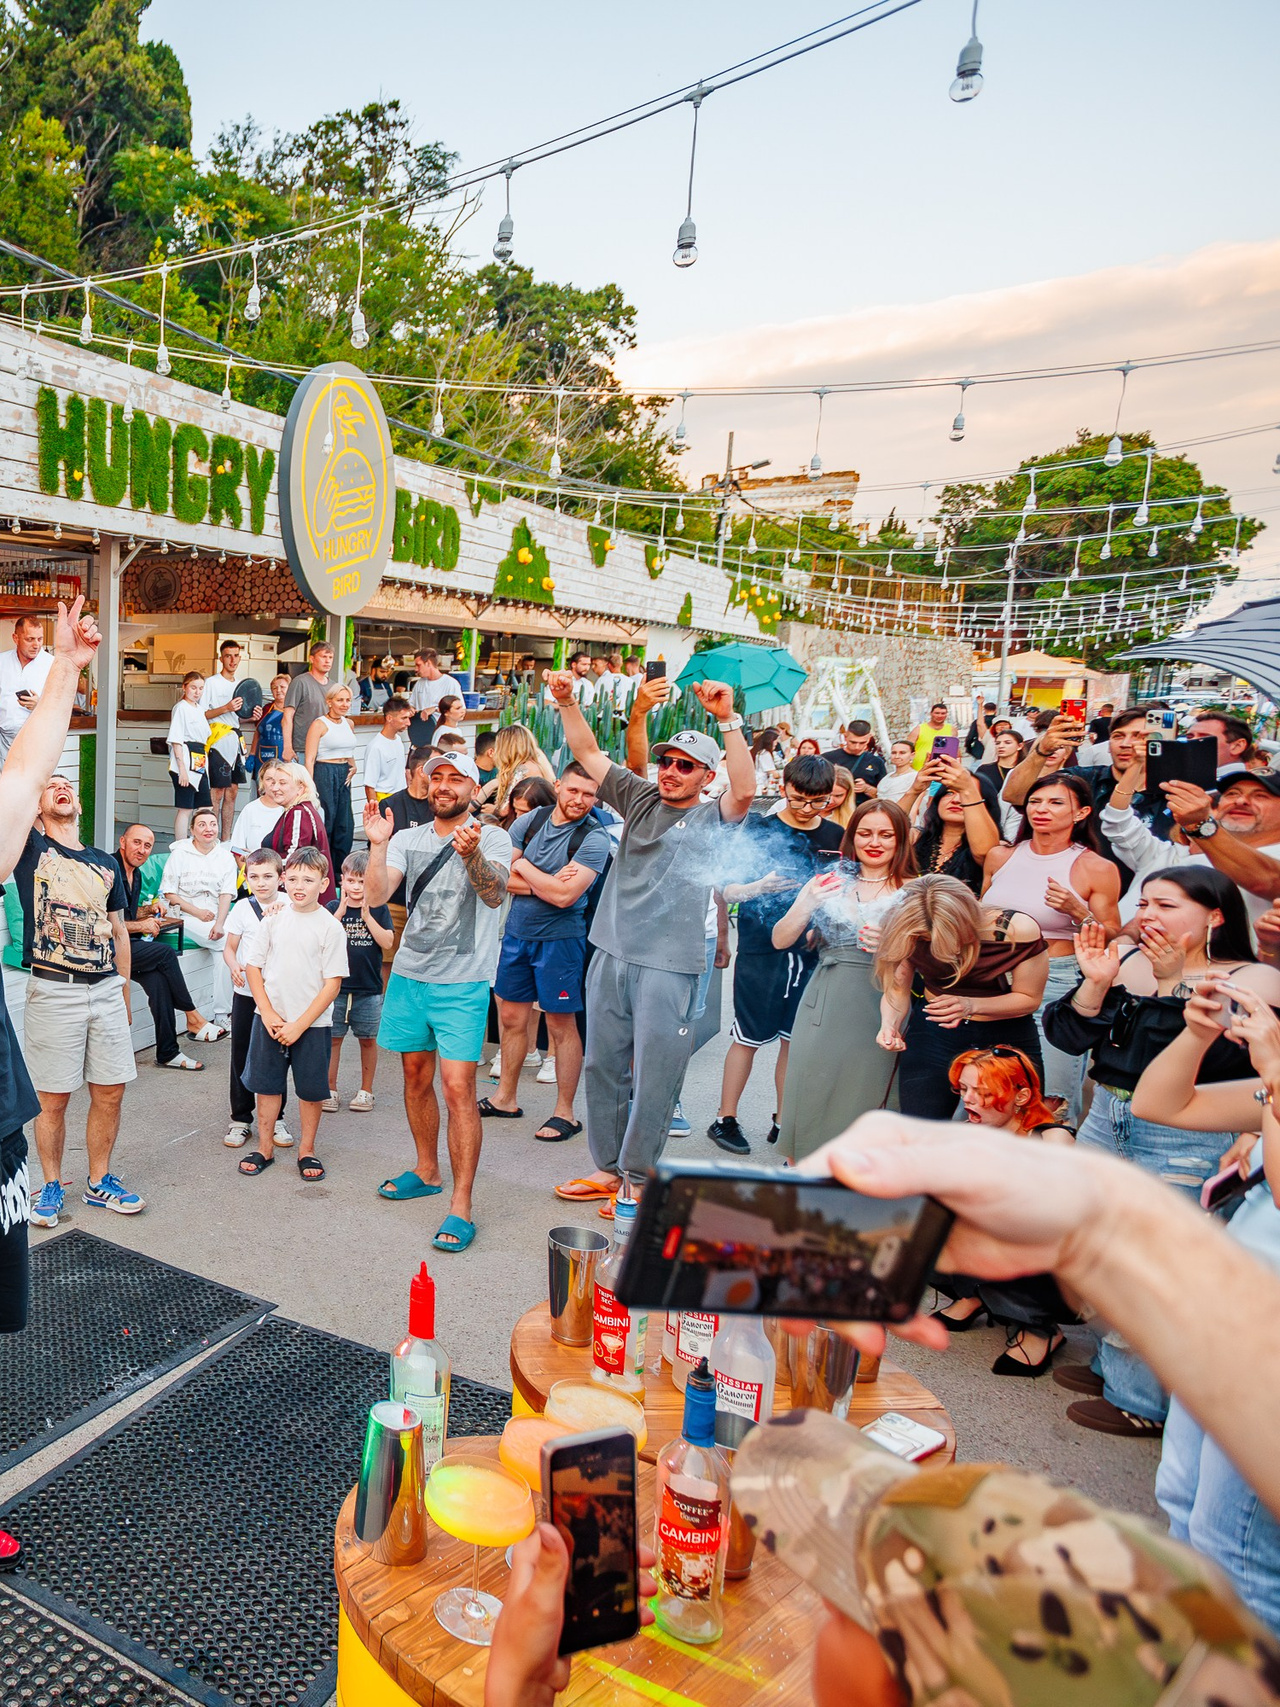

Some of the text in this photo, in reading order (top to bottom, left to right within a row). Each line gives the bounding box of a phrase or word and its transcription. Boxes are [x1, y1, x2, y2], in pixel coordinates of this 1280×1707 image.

[36, 385, 461, 571] HUNGRY BIRD
[323, 528, 373, 562] HUNGRY
[332, 571, 361, 600] BIRD
[717, 1371, 759, 1392] RUSSIAN
[673, 1499, 709, 1517] COFFEE
[660, 1522, 719, 1544] GAMBINI
